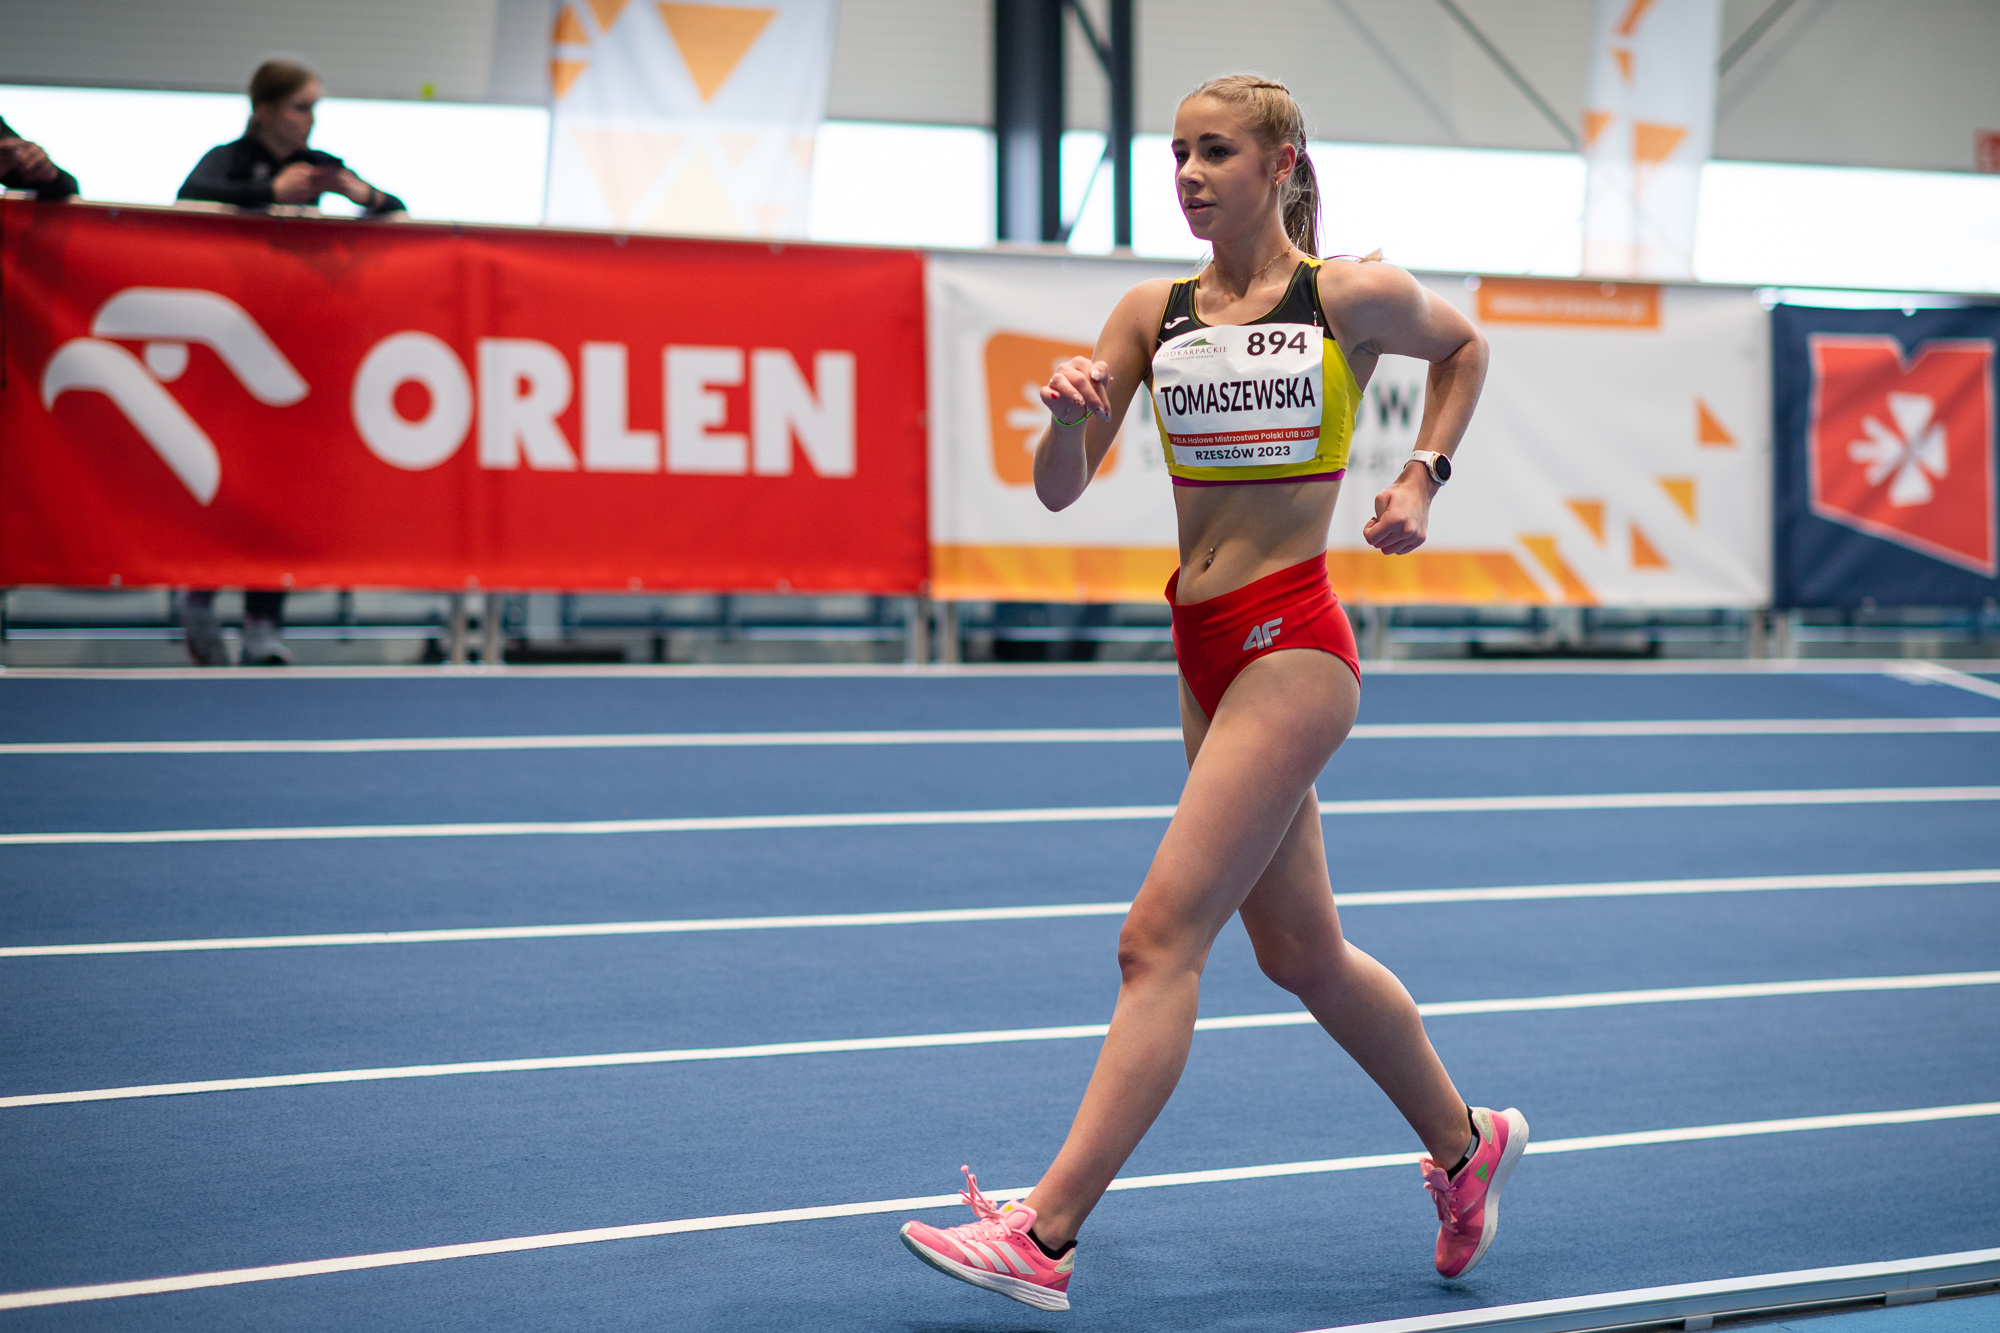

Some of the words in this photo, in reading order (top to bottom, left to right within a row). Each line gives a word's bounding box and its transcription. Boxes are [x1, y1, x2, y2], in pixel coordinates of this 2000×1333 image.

[1157, 346, 1228, 358] PODKARPACKIE
[1246, 331, 1308, 356] 894
[351, 330, 856, 478] ORLEN
[1160, 377, 1316, 417] TOMASZEWSKA
[1188, 436, 1213, 444] Halowe
[1214, 434, 1259, 443] Mistrzostwa
[1260, 431, 1284, 440] Polski
[1285, 430, 1299, 438] U18
[1300, 429, 1315, 438] U20
[1195, 446, 1254, 460] RZESZÓW
[1257, 445, 1291, 458] 2023
[1242, 617, 1283, 651] 4F
